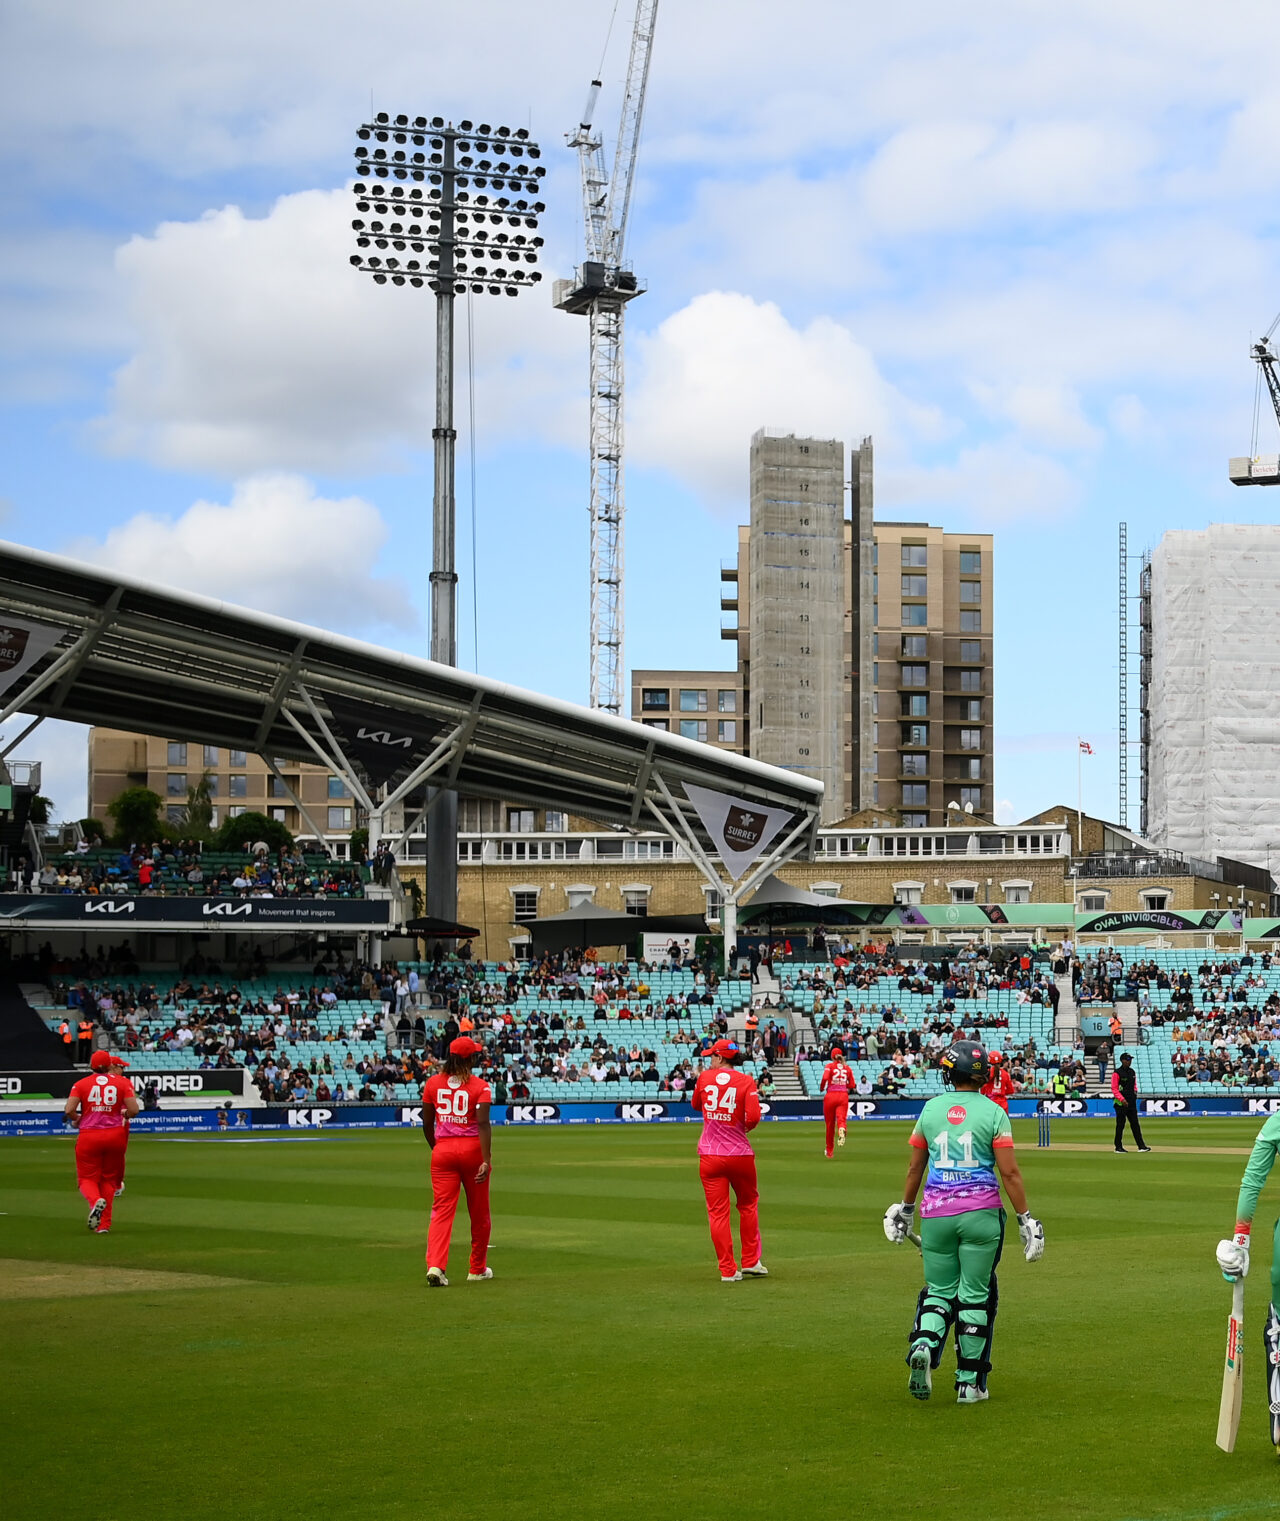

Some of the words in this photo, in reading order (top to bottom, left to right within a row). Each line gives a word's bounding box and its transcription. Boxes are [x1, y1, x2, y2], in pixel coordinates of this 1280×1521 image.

[799, 446, 809, 455] 18
[799, 484, 809, 492] 17
[799, 518, 809, 526] 16
[799, 549, 809, 557] 15
[799, 581, 809, 590] 14
[799, 614, 809, 623] 13
[0, 648, 19, 660] REY
[799, 646, 810, 655] 12
[799, 679, 809, 688] 11
[799, 712, 809, 720] 10
[798, 747, 809, 756] 09
[727, 825, 757, 841] SURREY
[258, 907, 294, 917] Movement
[296, 907, 308, 917] that
[310, 907, 336, 919] inspires
[1094, 915, 1121, 932] OVAL
[1121, 912, 1184, 931] INVINCIBLES
[1093, 1022, 1103, 1031] 16
[832, 1069, 848, 1081] 25
[131, 1075, 204, 1092] NDRED
[88, 1085, 117, 1105] 48
[704, 1085, 737, 1114] 34
[436, 1088, 469, 1116] 50
[1044, 1101, 1083, 1114] KP
[1147, 1100, 1186, 1114] KP
[289, 1109, 332, 1126] KP
[403, 1108, 423, 1123] K
[514, 1106, 555, 1121] KP
[623, 1105, 664, 1120] KP
[706, 1112, 732, 1122] ELWISS
[947, 1109, 967, 1120] Vitality
[0, 1118, 49, 1128] ethemarket
[128, 1115, 203, 1125] omparethemarket
[439, 1115, 468, 1124] ATTHEWS
[933, 1130, 979, 1168] 11
[942, 1171, 972, 1182] BATES
